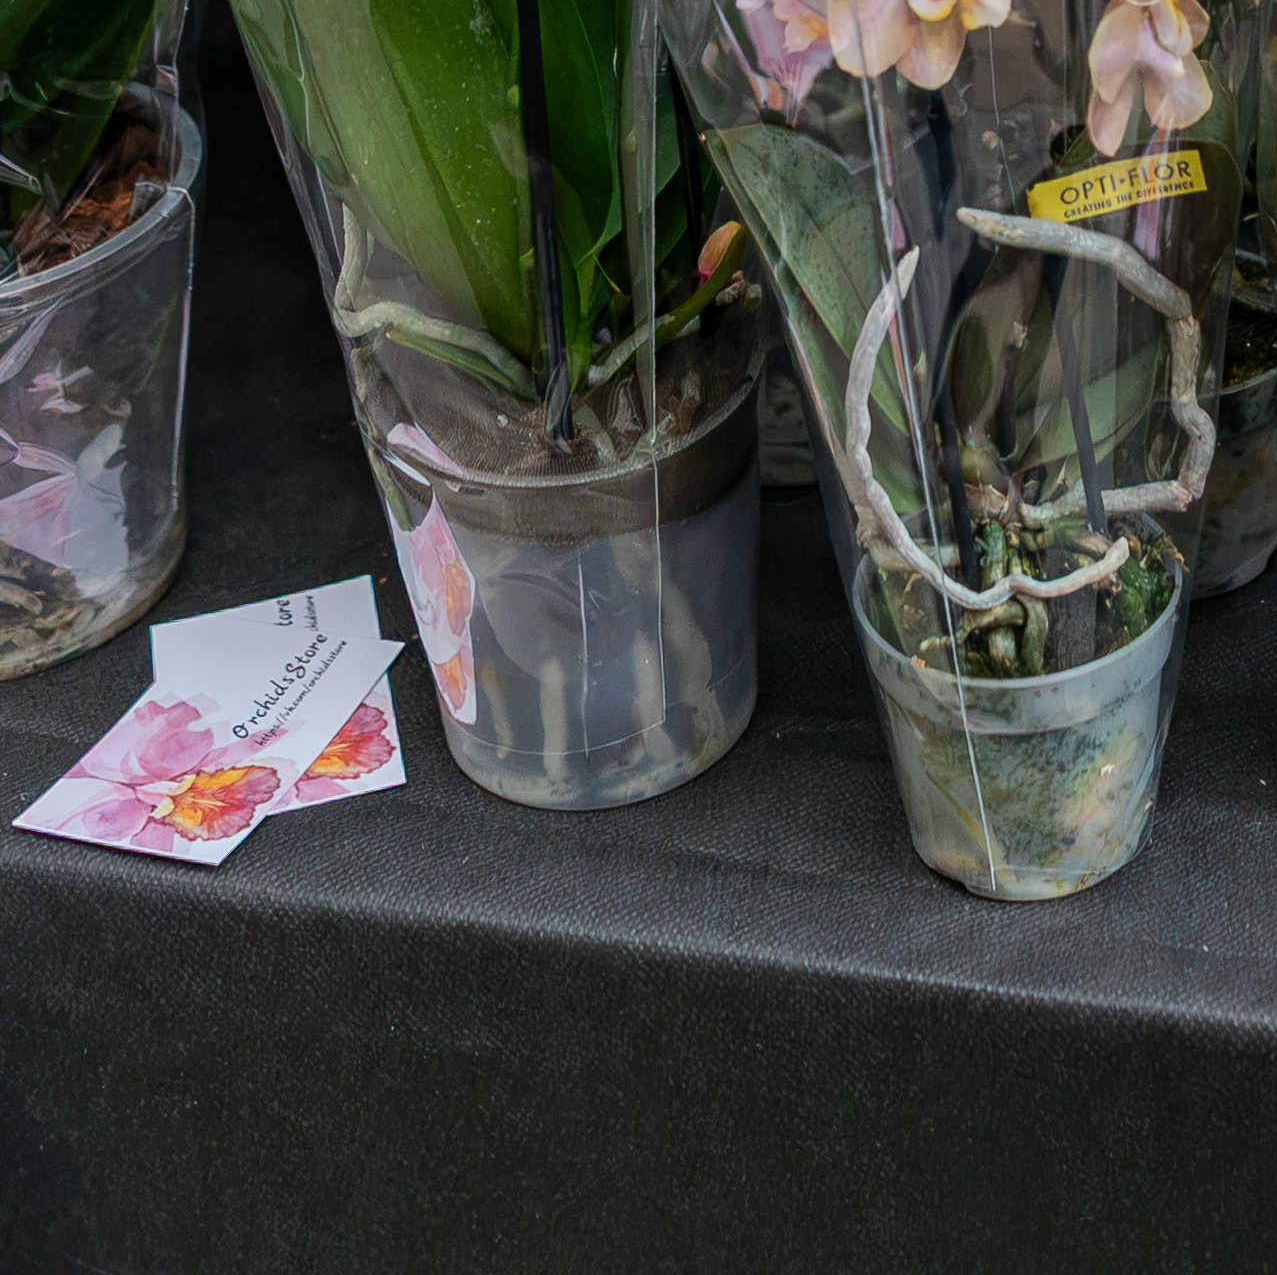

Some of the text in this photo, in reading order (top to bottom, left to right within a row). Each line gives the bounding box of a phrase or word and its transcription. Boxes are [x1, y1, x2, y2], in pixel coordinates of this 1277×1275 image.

[1064, 180, 1195, 219] CREATING THE DIFFERENCE
